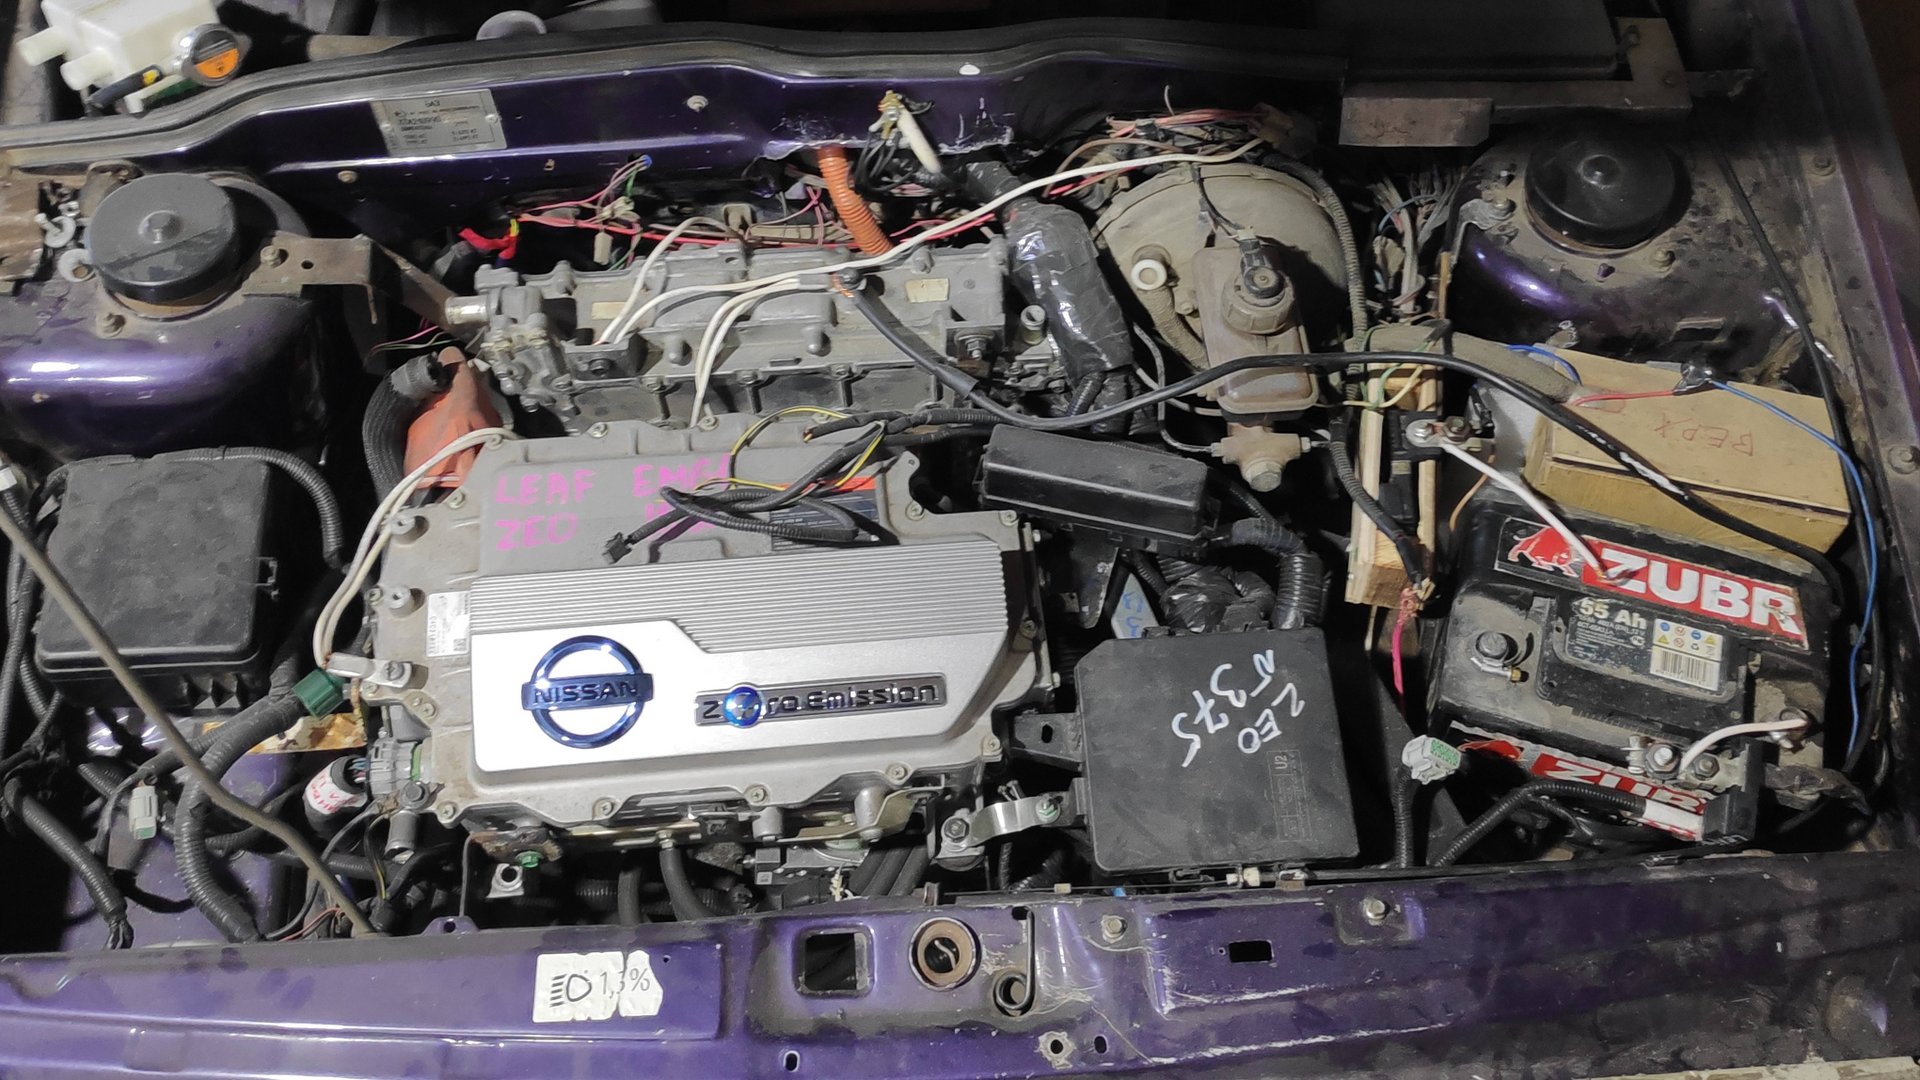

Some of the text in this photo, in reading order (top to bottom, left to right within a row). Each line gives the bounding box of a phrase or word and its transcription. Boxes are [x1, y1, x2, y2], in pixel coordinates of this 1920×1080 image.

[496, 469, 597, 506] LEAF
[1600, 548, 1802, 635] ZUBR
[1579, 600, 1610, 619] 55
[1614, 609, 1648, 631] Ah
[533, 681, 639, 704] NISSAN
[808, 682, 939, 711] Emission
[1274, 754, 1289, 770] U2
